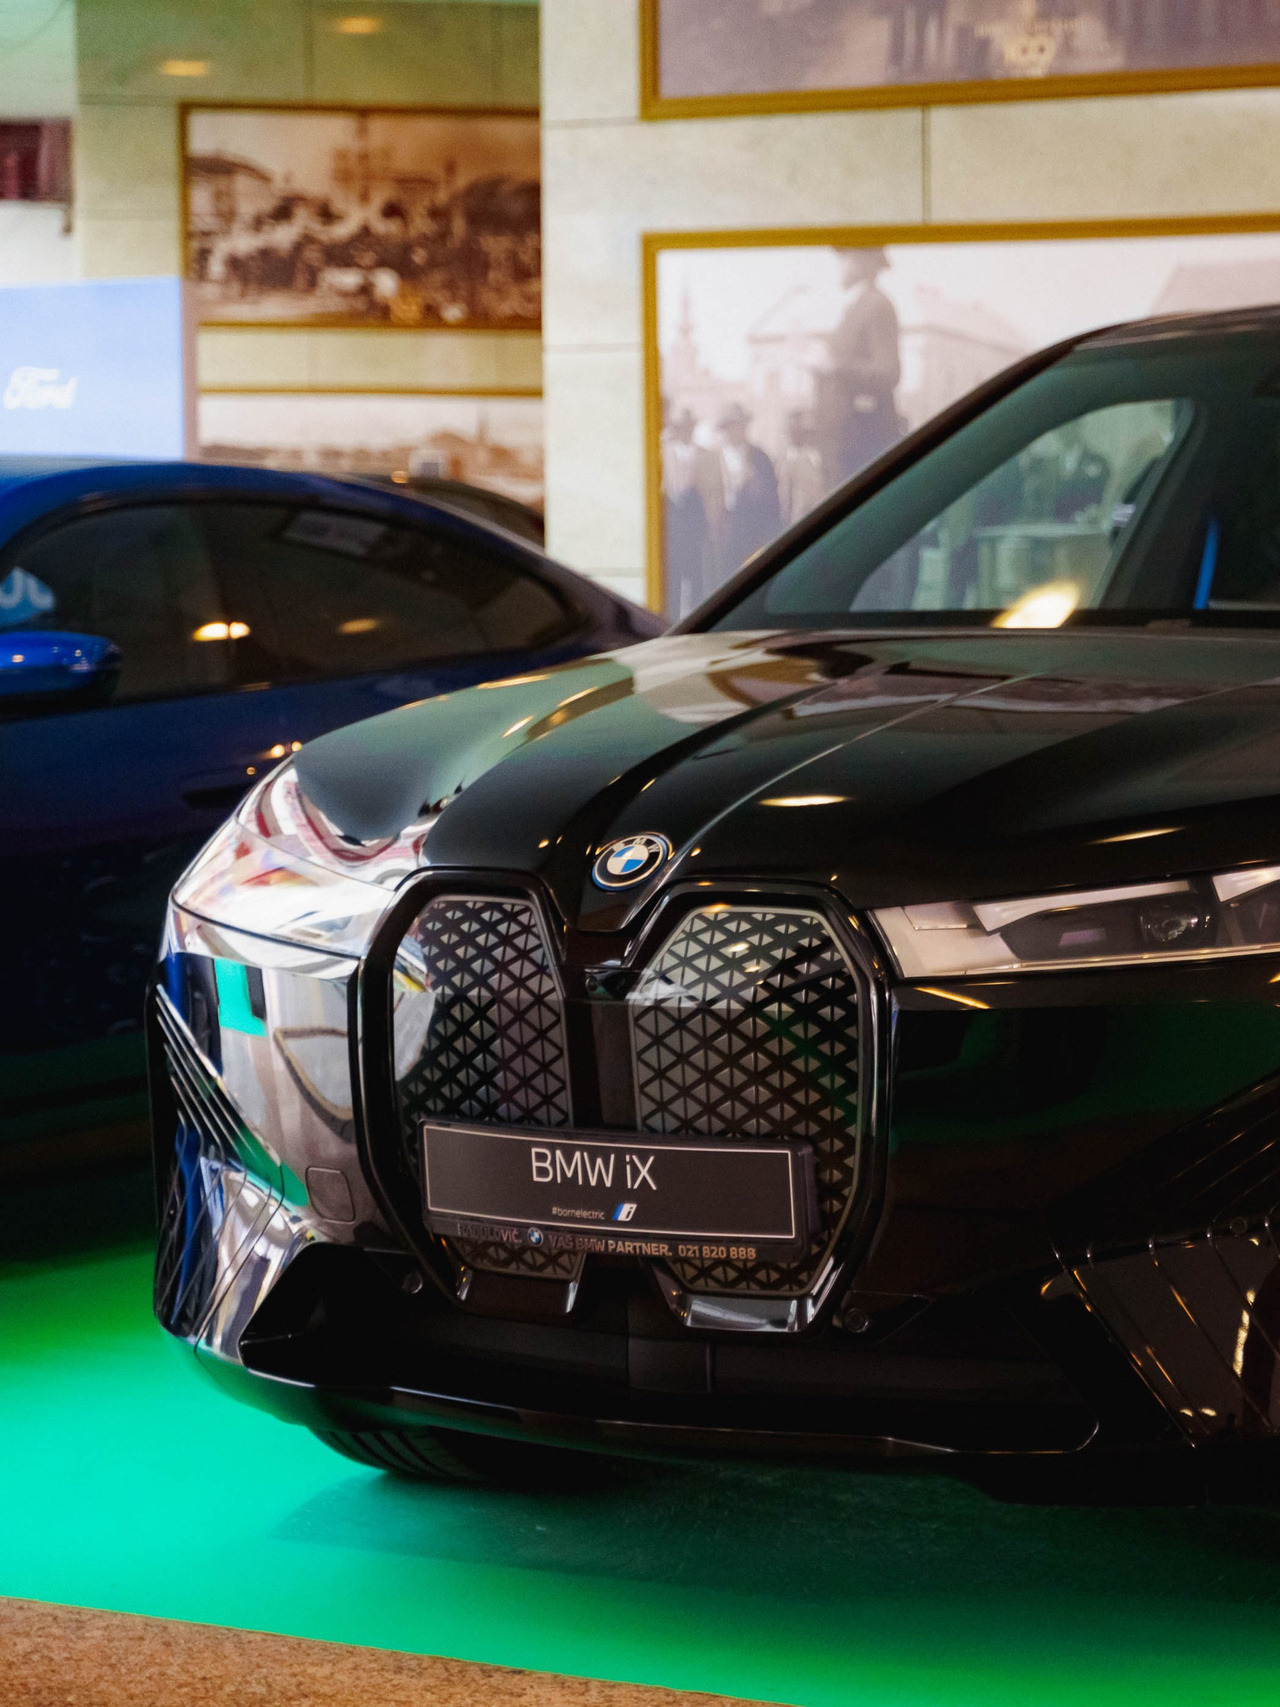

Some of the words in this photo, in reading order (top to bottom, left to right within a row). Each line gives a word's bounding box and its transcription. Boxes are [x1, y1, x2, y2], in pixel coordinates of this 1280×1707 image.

[3, 366, 78, 410] Ford
[532, 1148, 615, 1187] BMW
[625, 1155, 657, 1191] iX
[552, 1207, 605, 1221] #bornelectric
[548, 1232, 574, 1249] VAŠ
[576, 1237, 605, 1253] BMW
[607, 1240, 673, 1257] PARTNER.
[678, 1244, 700, 1258] 021
[702, 1245, 728, 1259] 820
[730, 1246, 756, 1260] 888
